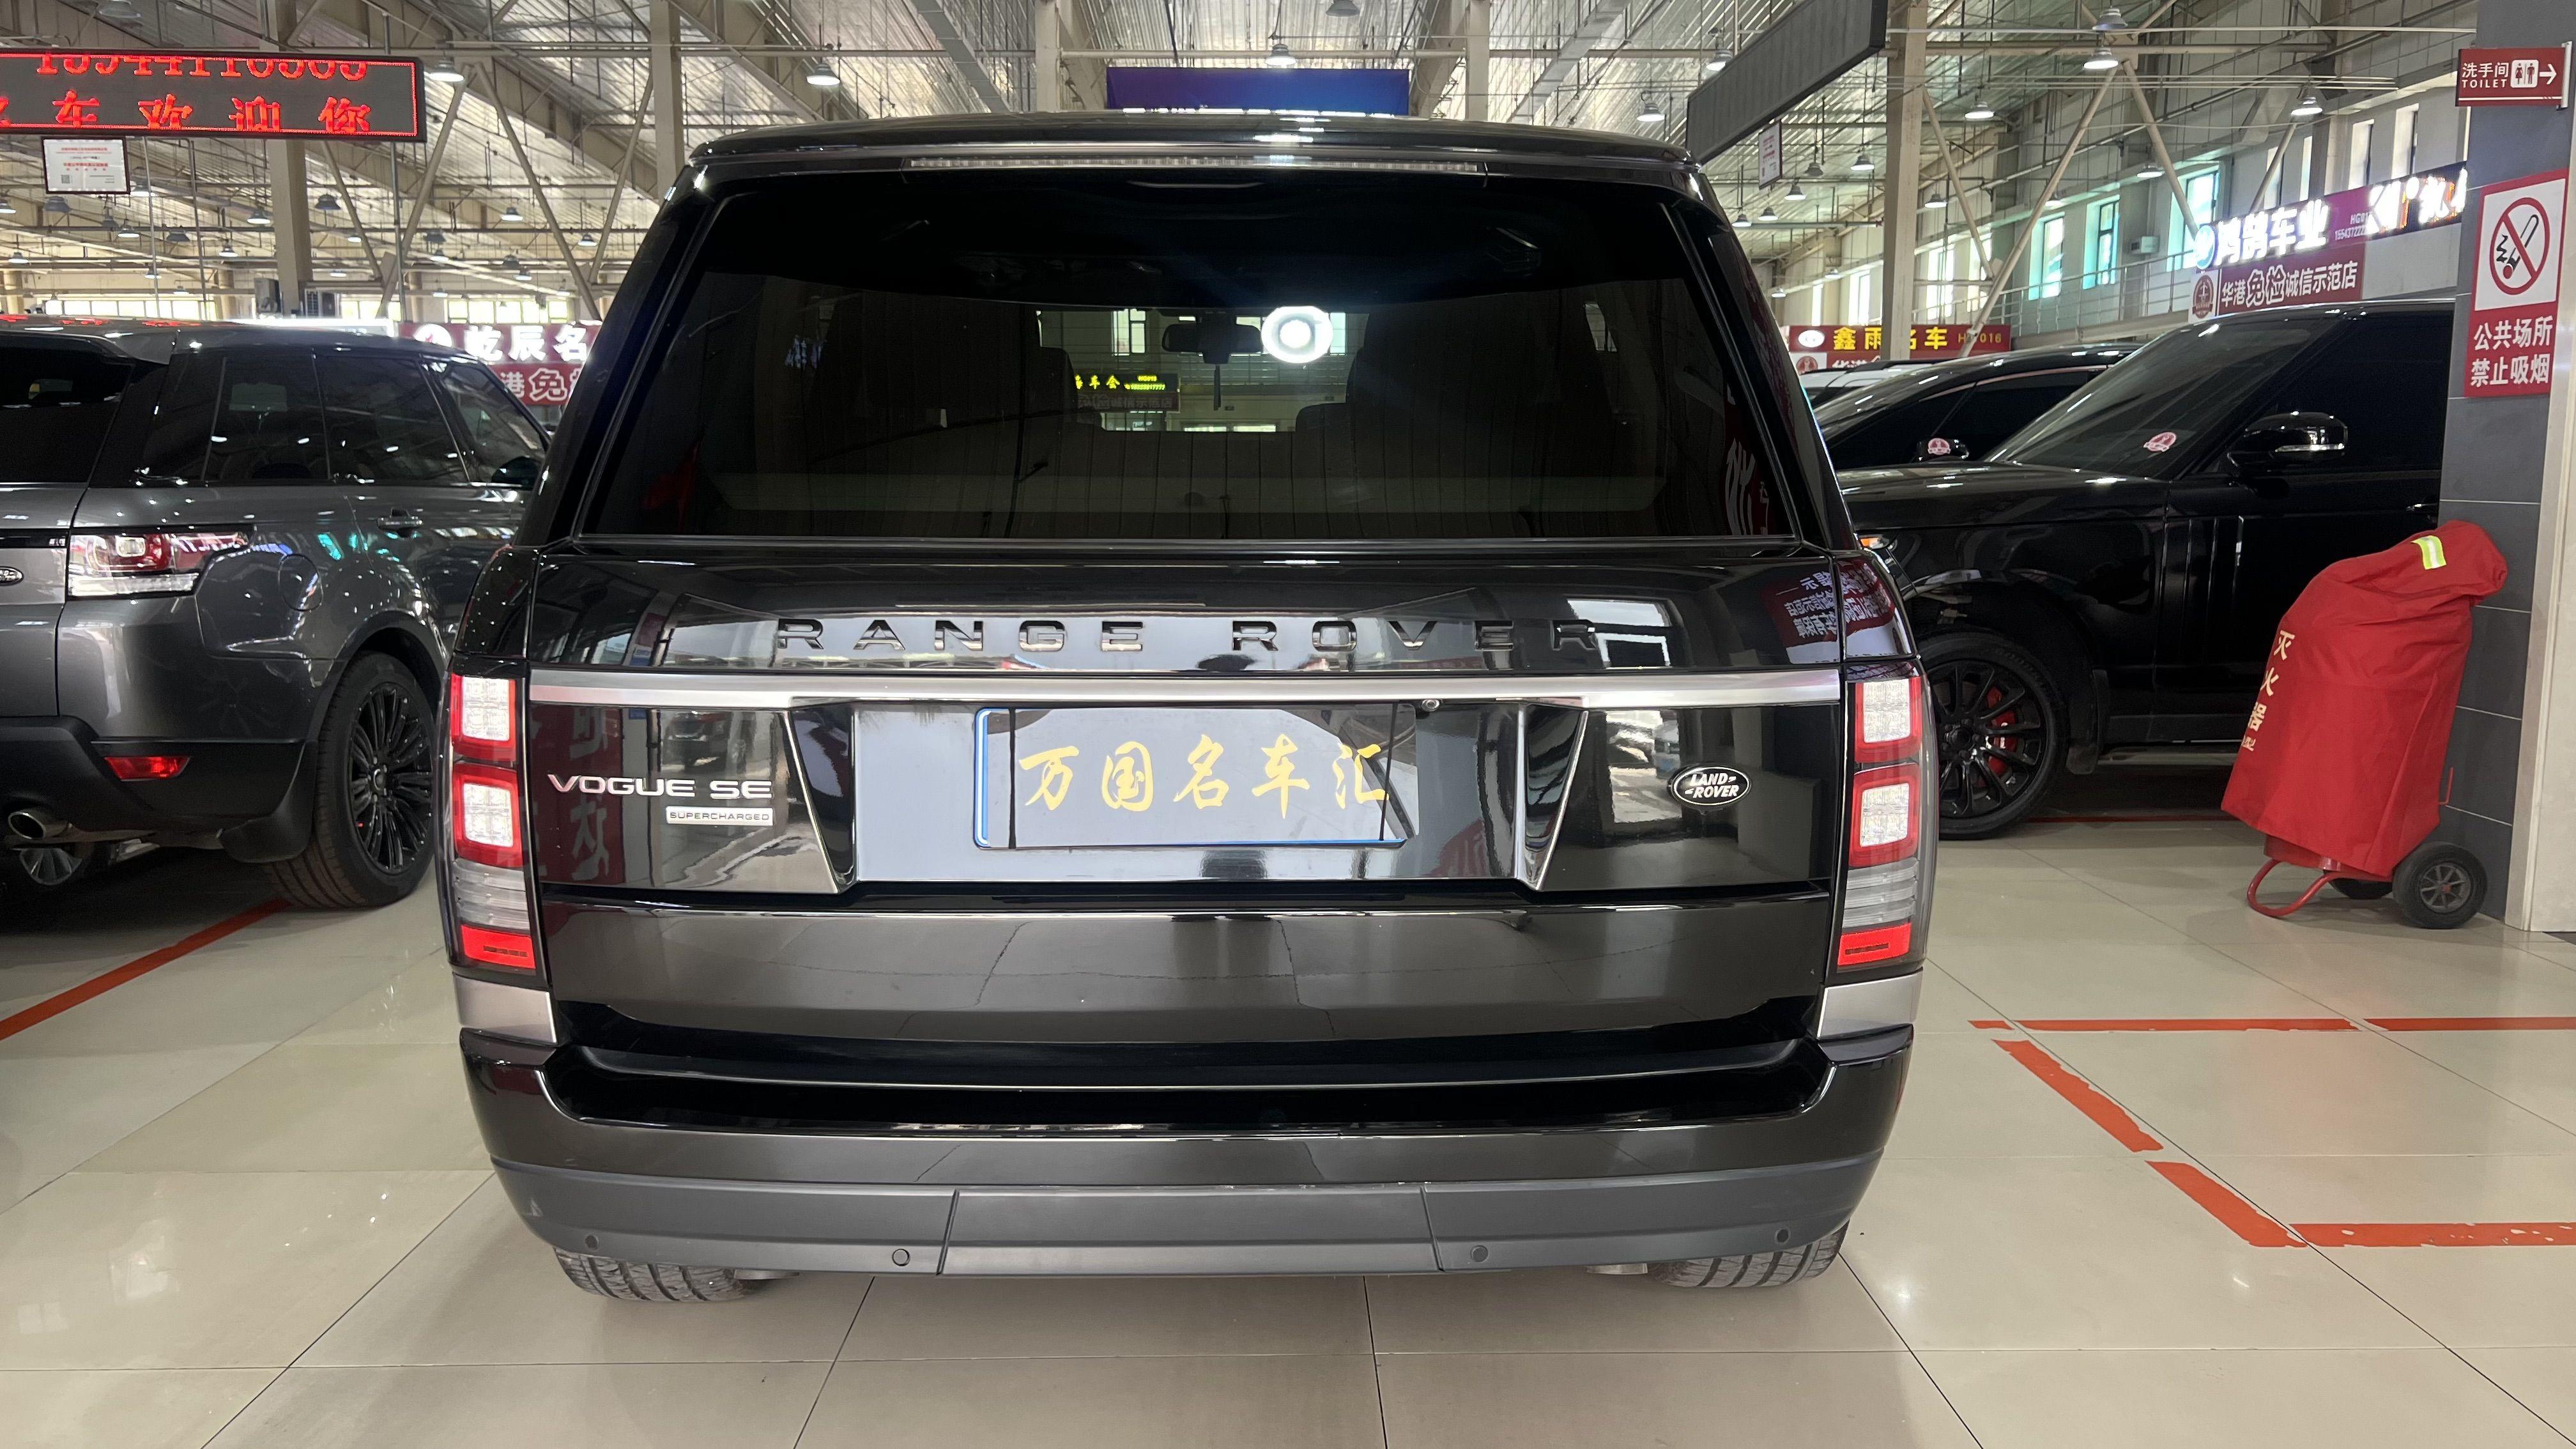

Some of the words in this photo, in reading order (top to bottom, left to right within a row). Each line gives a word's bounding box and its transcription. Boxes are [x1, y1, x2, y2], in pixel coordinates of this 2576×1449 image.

[2462, 62, 2510, 78] 洗手间
[2462, 79, 2508, 88] TOILET
[0, 89, 371, 132] 车欢迎你
[2473, 315, 2553, 351] 公共场所
[2471, 353, 2550, 388] 禁止吸烟
[777, 618, 1145, 652] RANGE
[1232, 620, 1598, 652] ROVER
[547, 774, 695, 797] VOGUE
[709, 780, 772, 799] SE
[1018, 733, 1390, 820] 万国名车汇
[1689, 772, 1728, 786] LAND
[1692, 785, 1739, 799] ROVER
[670, 811, 770, 820] SUPERCHARGED
